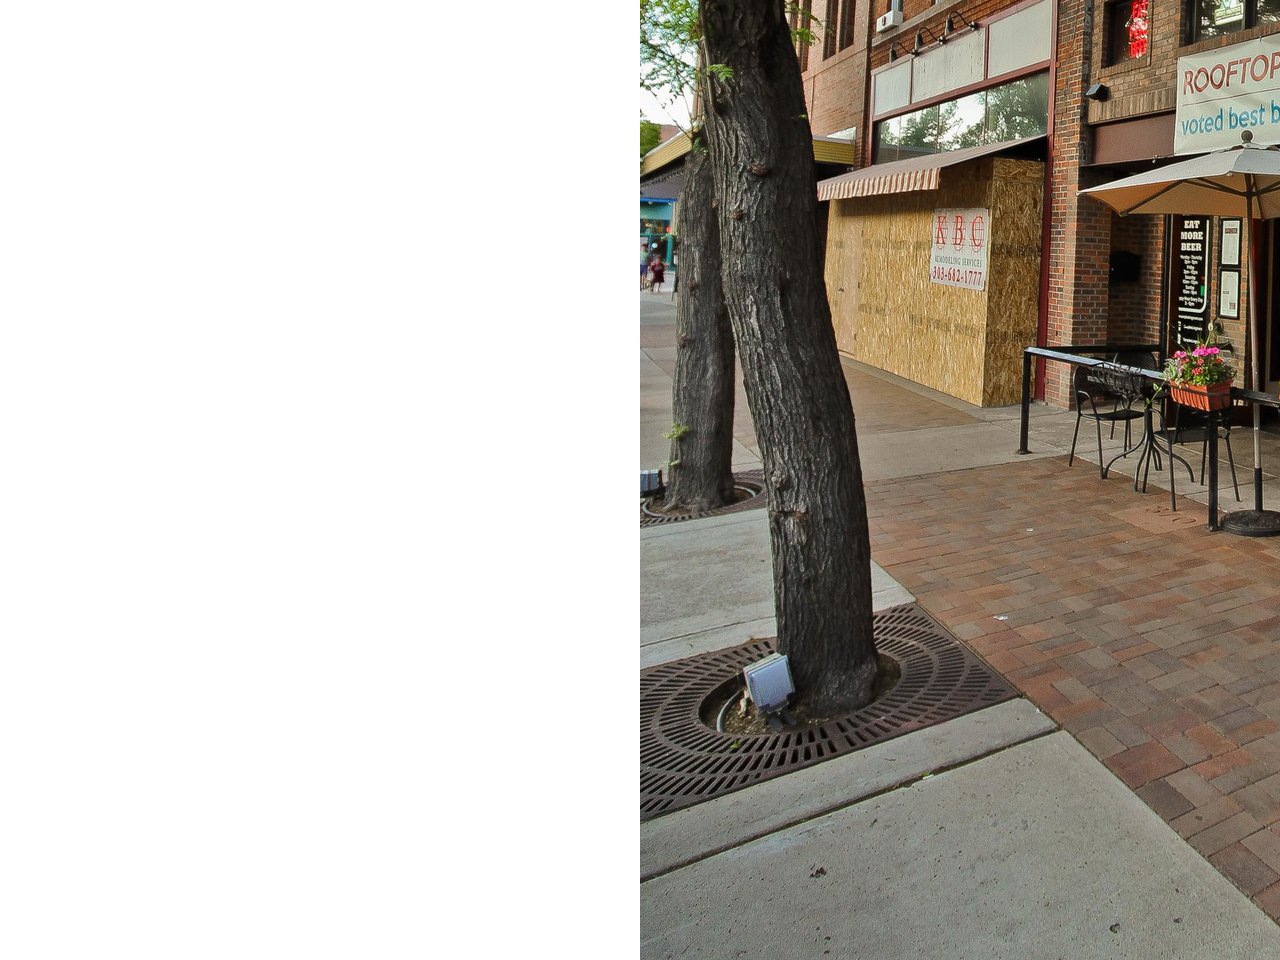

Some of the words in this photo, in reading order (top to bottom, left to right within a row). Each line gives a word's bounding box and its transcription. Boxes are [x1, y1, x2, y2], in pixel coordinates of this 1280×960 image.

[1181, 108, 1223, 136] voted
[1229, 104, 1265, 130] best
[1184, 220, 1200, 229] EAT
[1180, 231, 1204, 240] MORE
[1181, 242, 1202, 251] BEER
[934, 255, 960, 266] REMODELING
[961, 257, 982, 268] SERVICES
[932, 266, 983, 286] 303-682-1777
